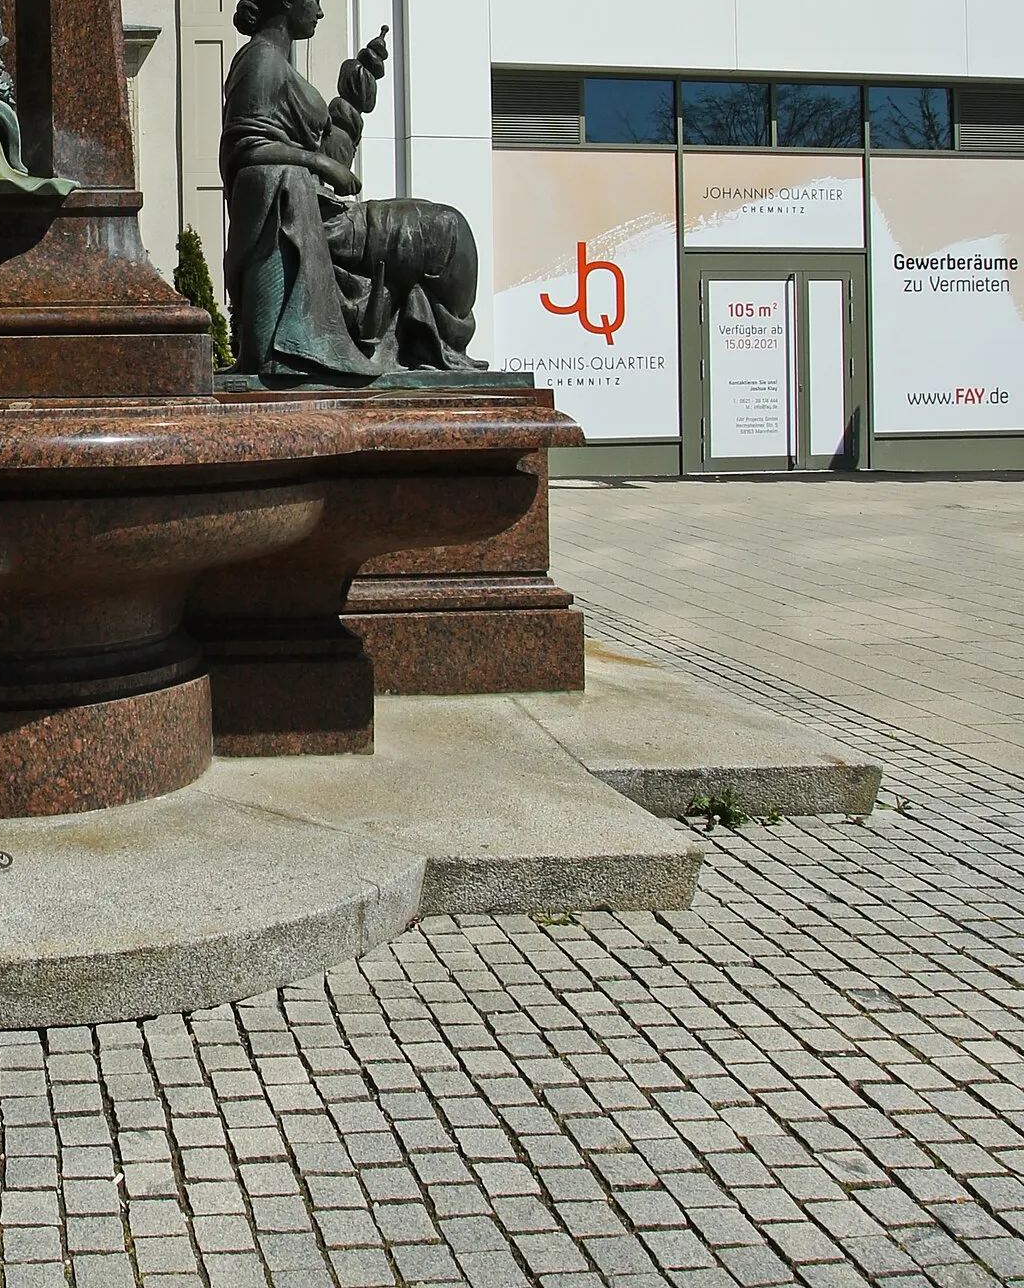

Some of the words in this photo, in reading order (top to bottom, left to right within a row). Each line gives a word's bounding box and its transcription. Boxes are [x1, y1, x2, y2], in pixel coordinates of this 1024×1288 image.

[702, 186, 843, 200] JOHANNIS-QUARTIER
[742, 206, 805, 214] CHEMNITZ
[893, 253, 1019, 270] Gewerberäume
[903, 279, 922, 292] zu
[929, 275, 1010, 292] Vermieten
[728, 303, 754, 317] 105
[718, 324, 767, 337] Verfügbar
[770, 324, 783, 335] ab
[725, 338, 778, 349] 15.09.2021
[500, 356, 665, 372] JOHANNIS-QUARTIER
[547, 377, 621, 386] CHEMNITZ
[907, 387, 1009, 405] www.FAY.de
